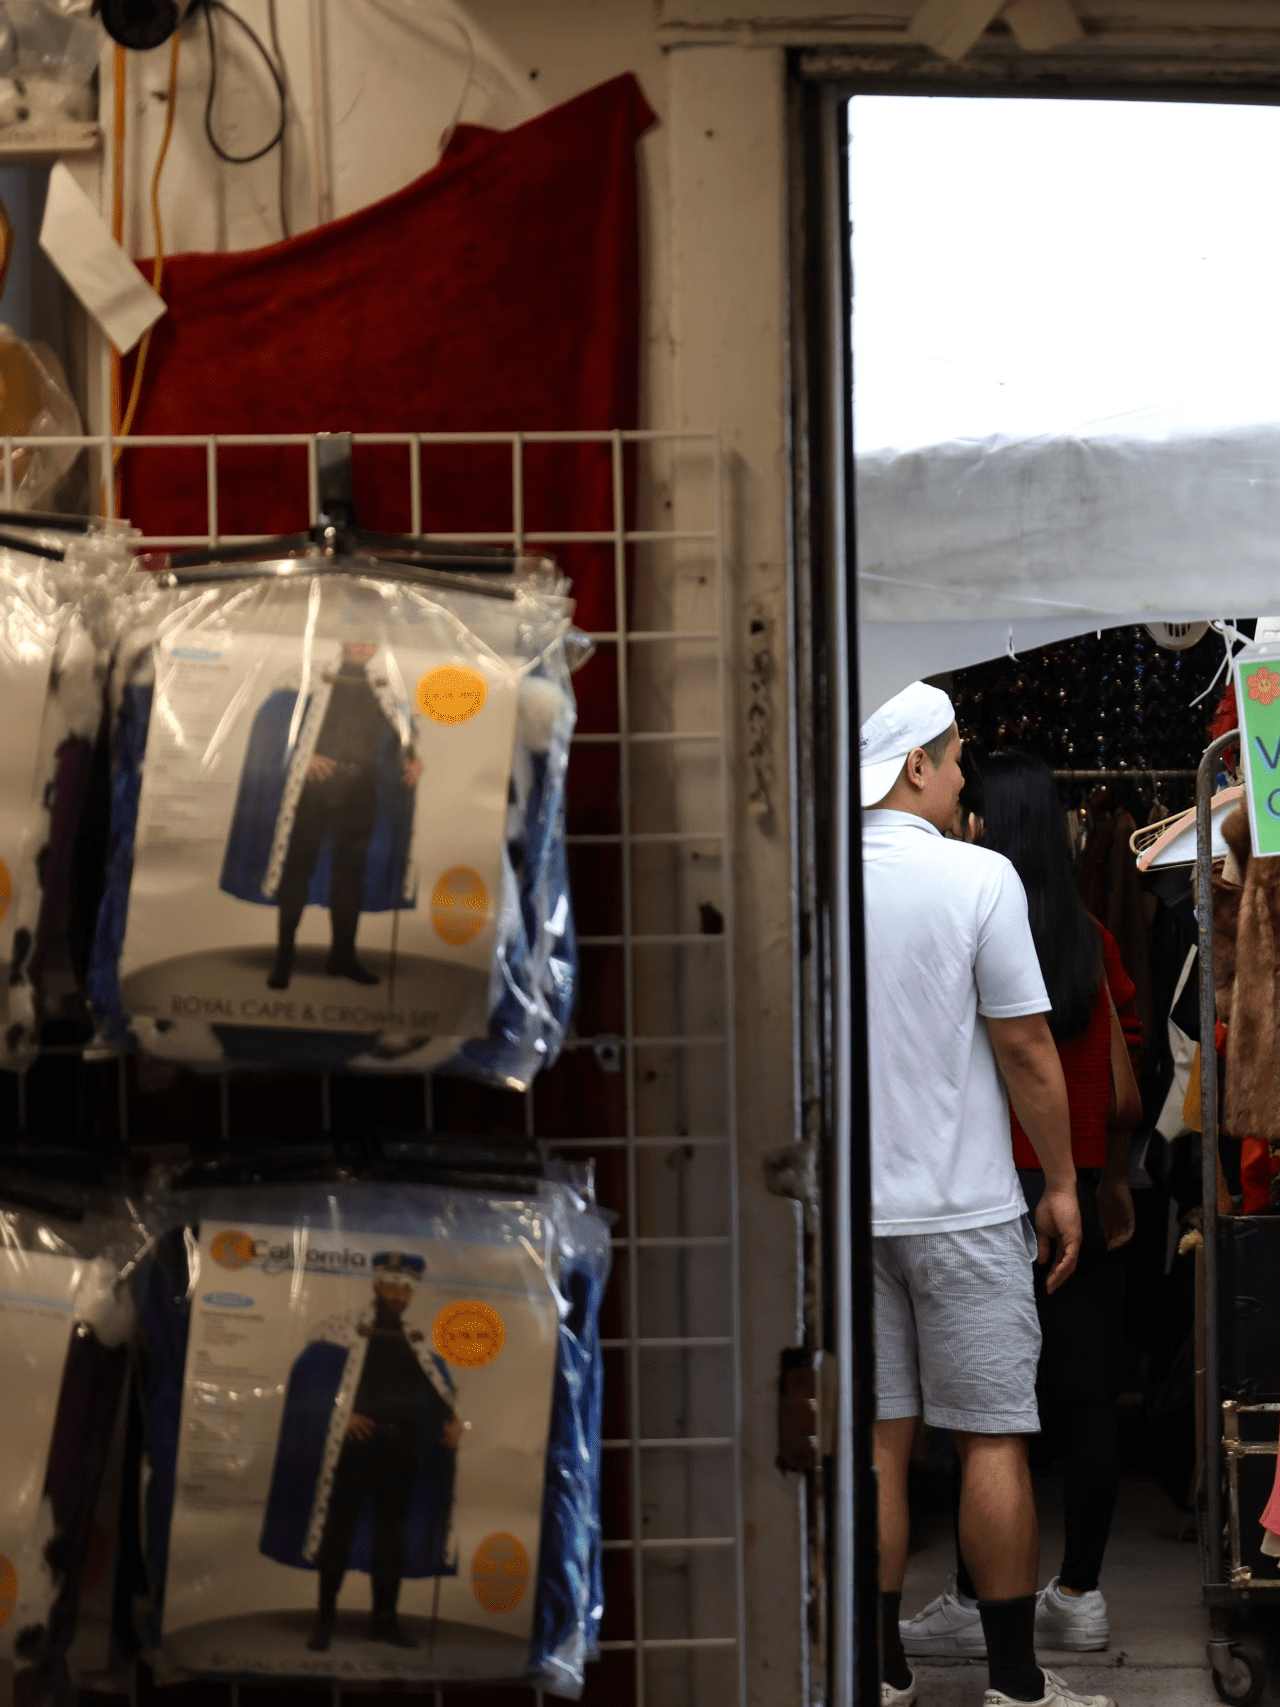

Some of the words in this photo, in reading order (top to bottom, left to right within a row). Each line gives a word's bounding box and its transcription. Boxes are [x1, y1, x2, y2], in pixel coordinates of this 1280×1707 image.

[171, 994, 233, 1017] ROYAL
[240, 999, 296, 1020] CAPE
[301, 1003, 316, 1021] &
[248, 1239, 365, 1267] Calornia
